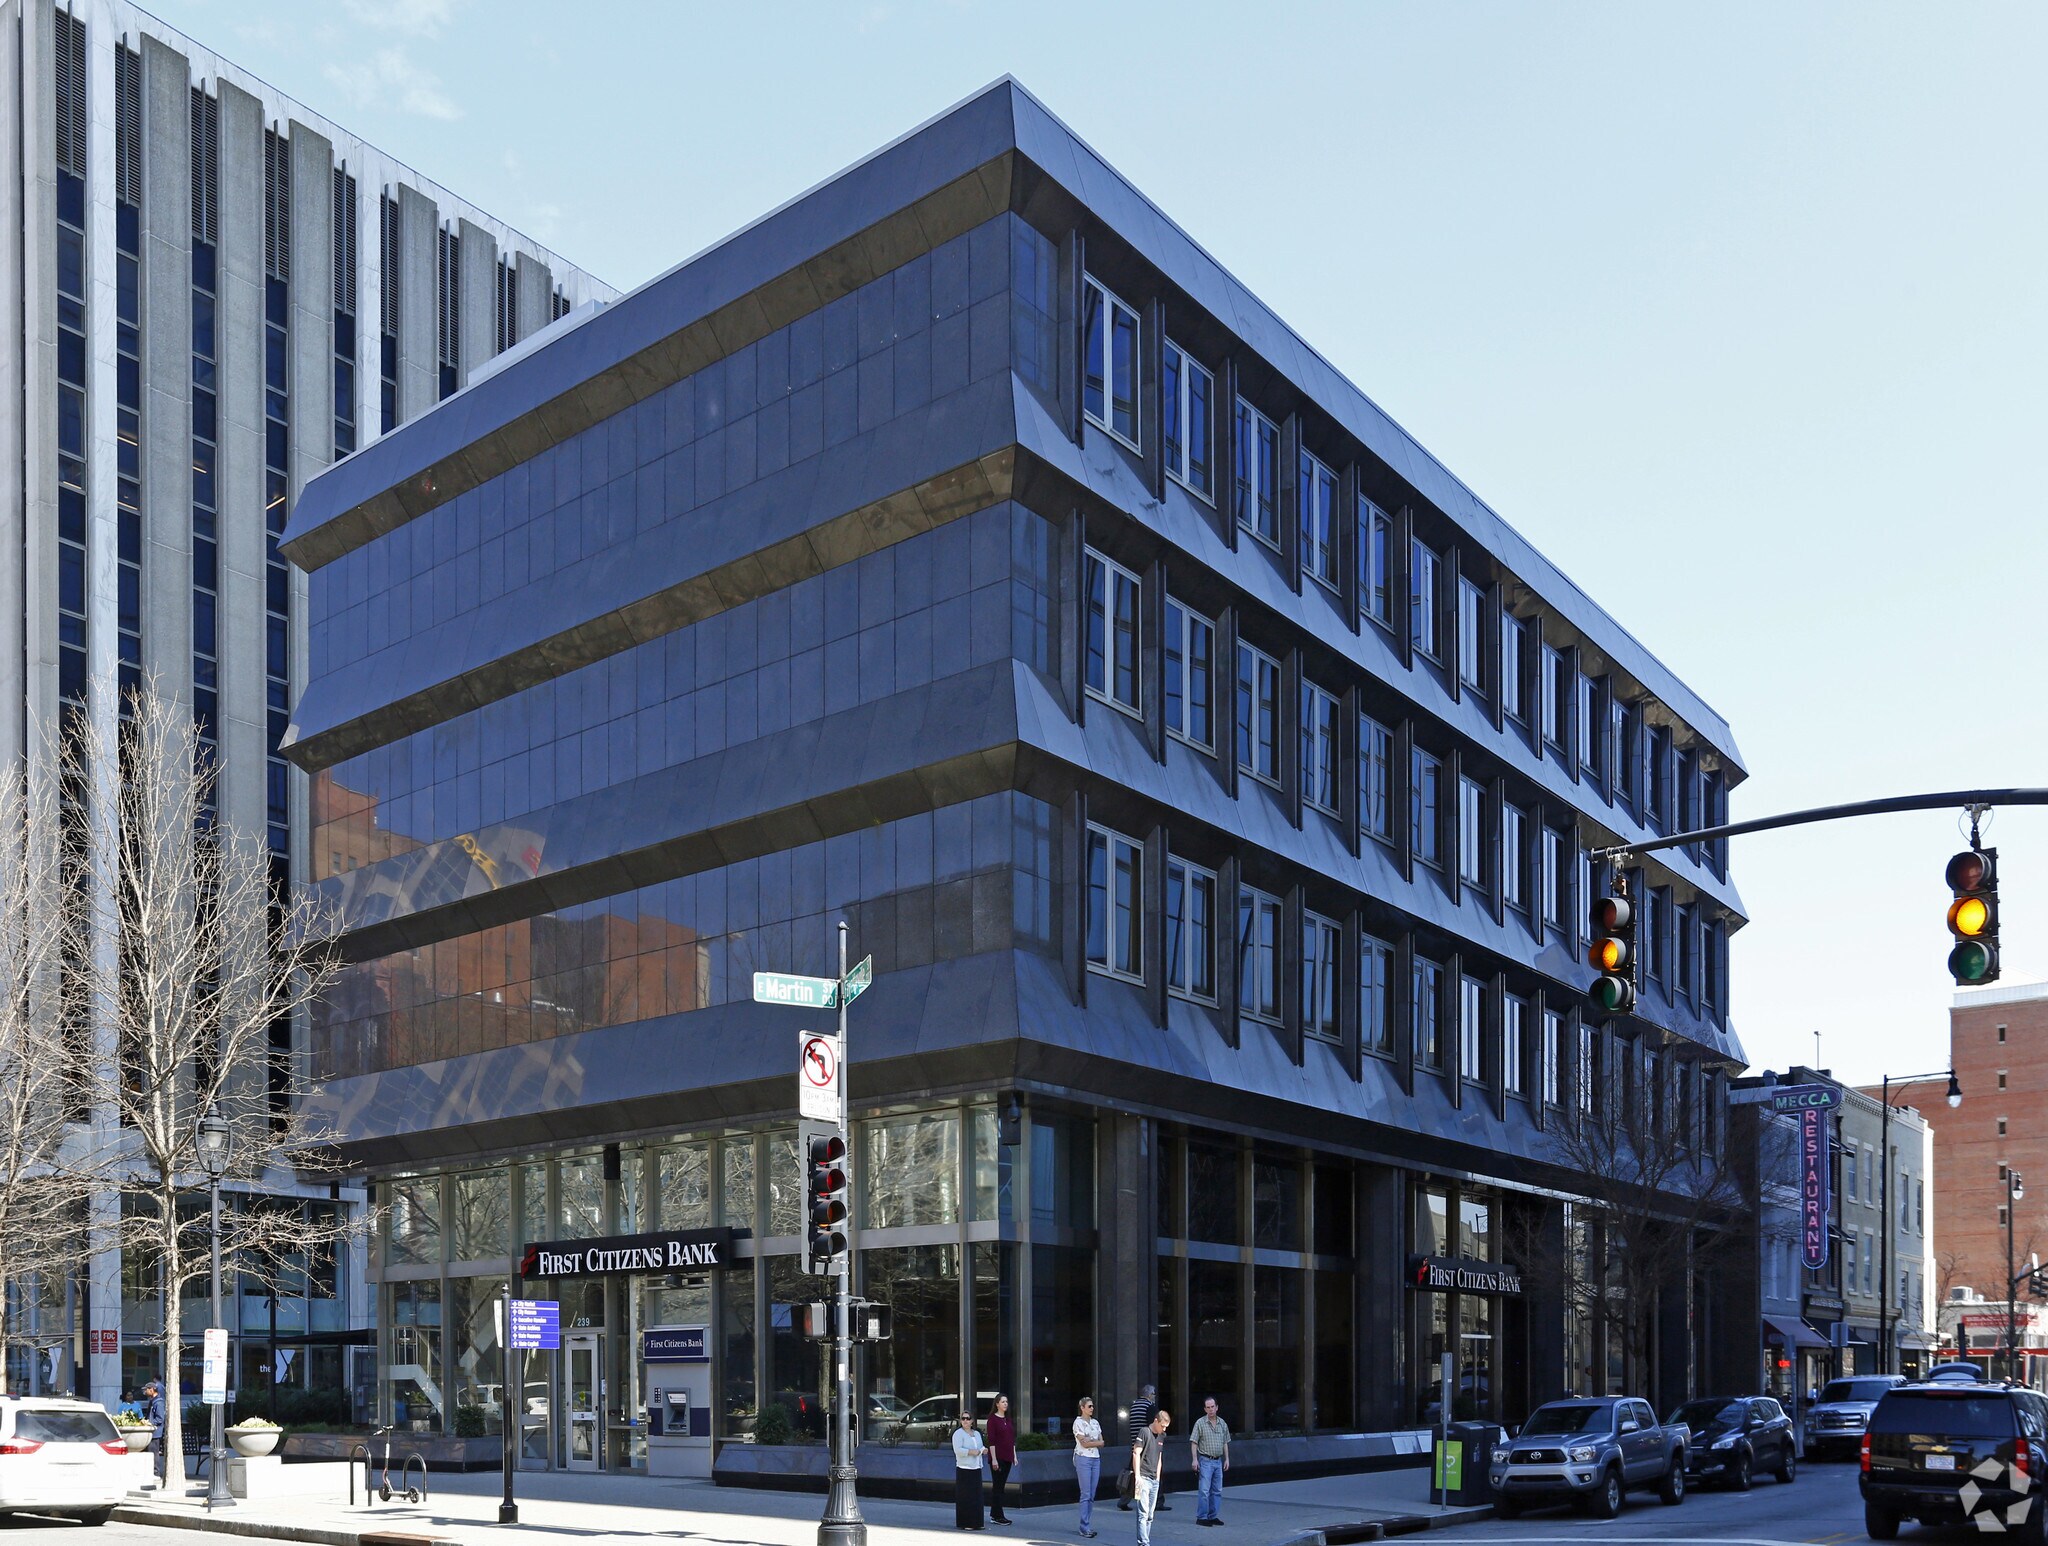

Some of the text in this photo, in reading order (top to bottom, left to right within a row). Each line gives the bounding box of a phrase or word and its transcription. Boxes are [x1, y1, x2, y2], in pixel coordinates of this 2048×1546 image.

[758, 978, 833, 1002] E Martin ST
[1775, 1093, 1831, 1109] MECCA
[1805, 1110, 1819, 1258] RESTAURANT
[539, 1241, 718, 1276] FIRST CITIZENS BANK
[1429, 1265, 1521, 1293] FIRST CITIZENS BANK
[577, 1317, 590, 1327] 239
[651, 1339, 703, 1348] First Citizens Bank
[207, 1362, 211, 1373] 2
[260, 1364, 271, 1373] the
